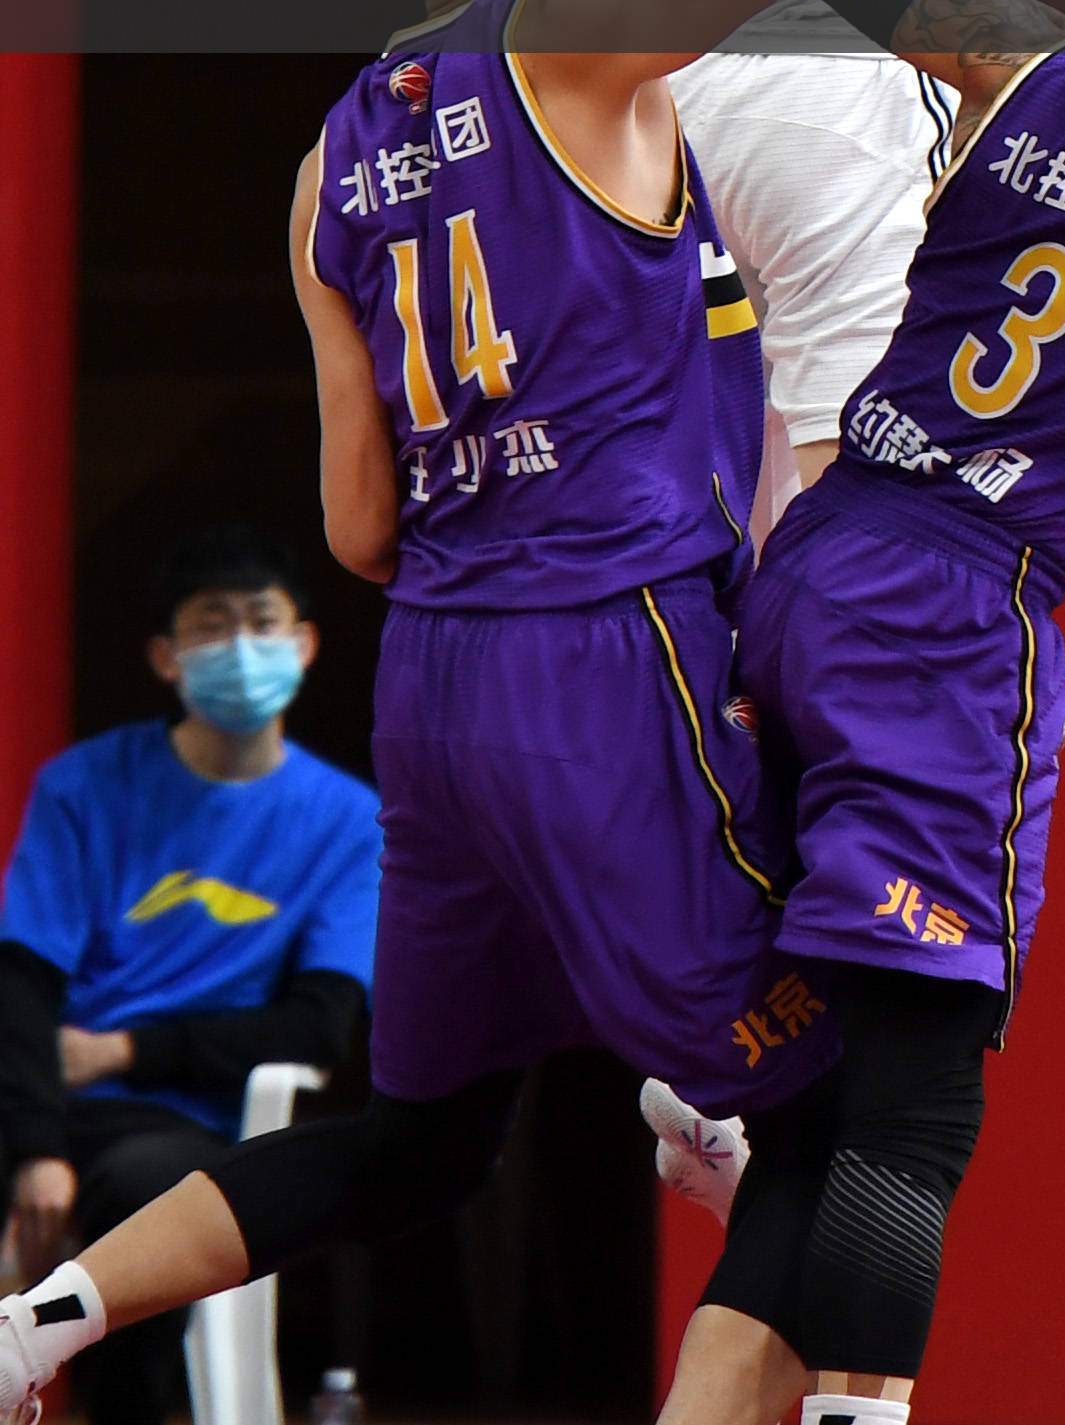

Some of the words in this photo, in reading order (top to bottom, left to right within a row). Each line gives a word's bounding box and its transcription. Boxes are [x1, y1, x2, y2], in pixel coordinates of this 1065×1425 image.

[339, 95, 492, 217] 北控团
[388, 209, 517, 433] 14
[874, 877, 971, 946] 北京
[730, 972, 827, 1069] 北京
